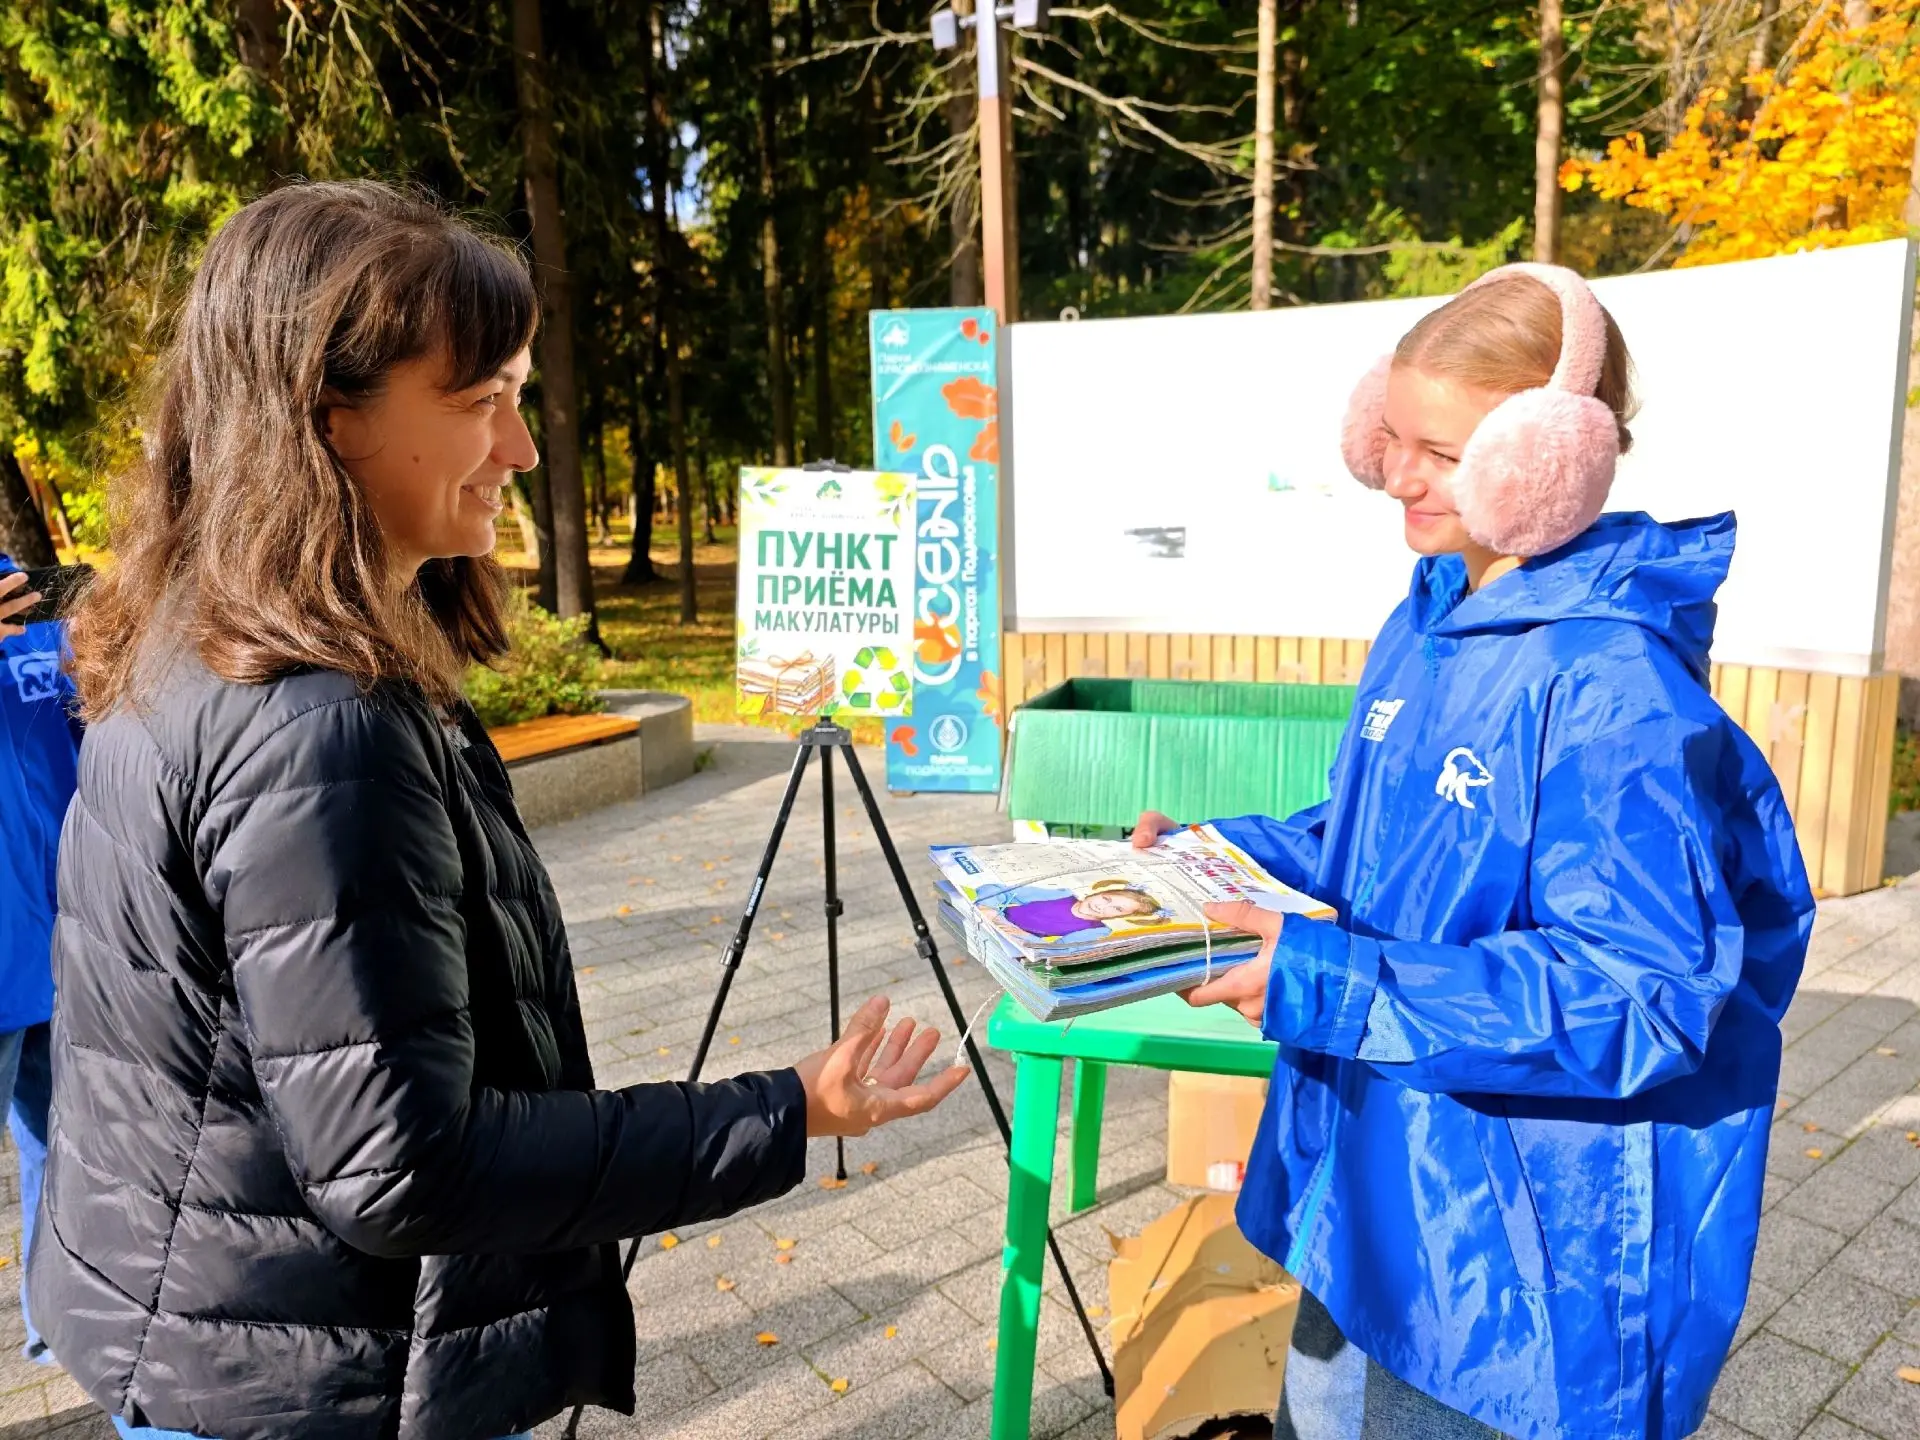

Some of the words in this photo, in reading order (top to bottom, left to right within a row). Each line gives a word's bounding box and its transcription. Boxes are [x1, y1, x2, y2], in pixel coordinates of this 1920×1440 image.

[961, 465, 980, 583] Подмосковья
[757, 530, 898, 571] ПУНКТ
[757, 570, 897, 608] ПРИЁМА
[754, 609, 899, 635] МАКУЛАТУРЫ
[965, 585, 981, 649] парках
[965, 650, 979, 662] в
